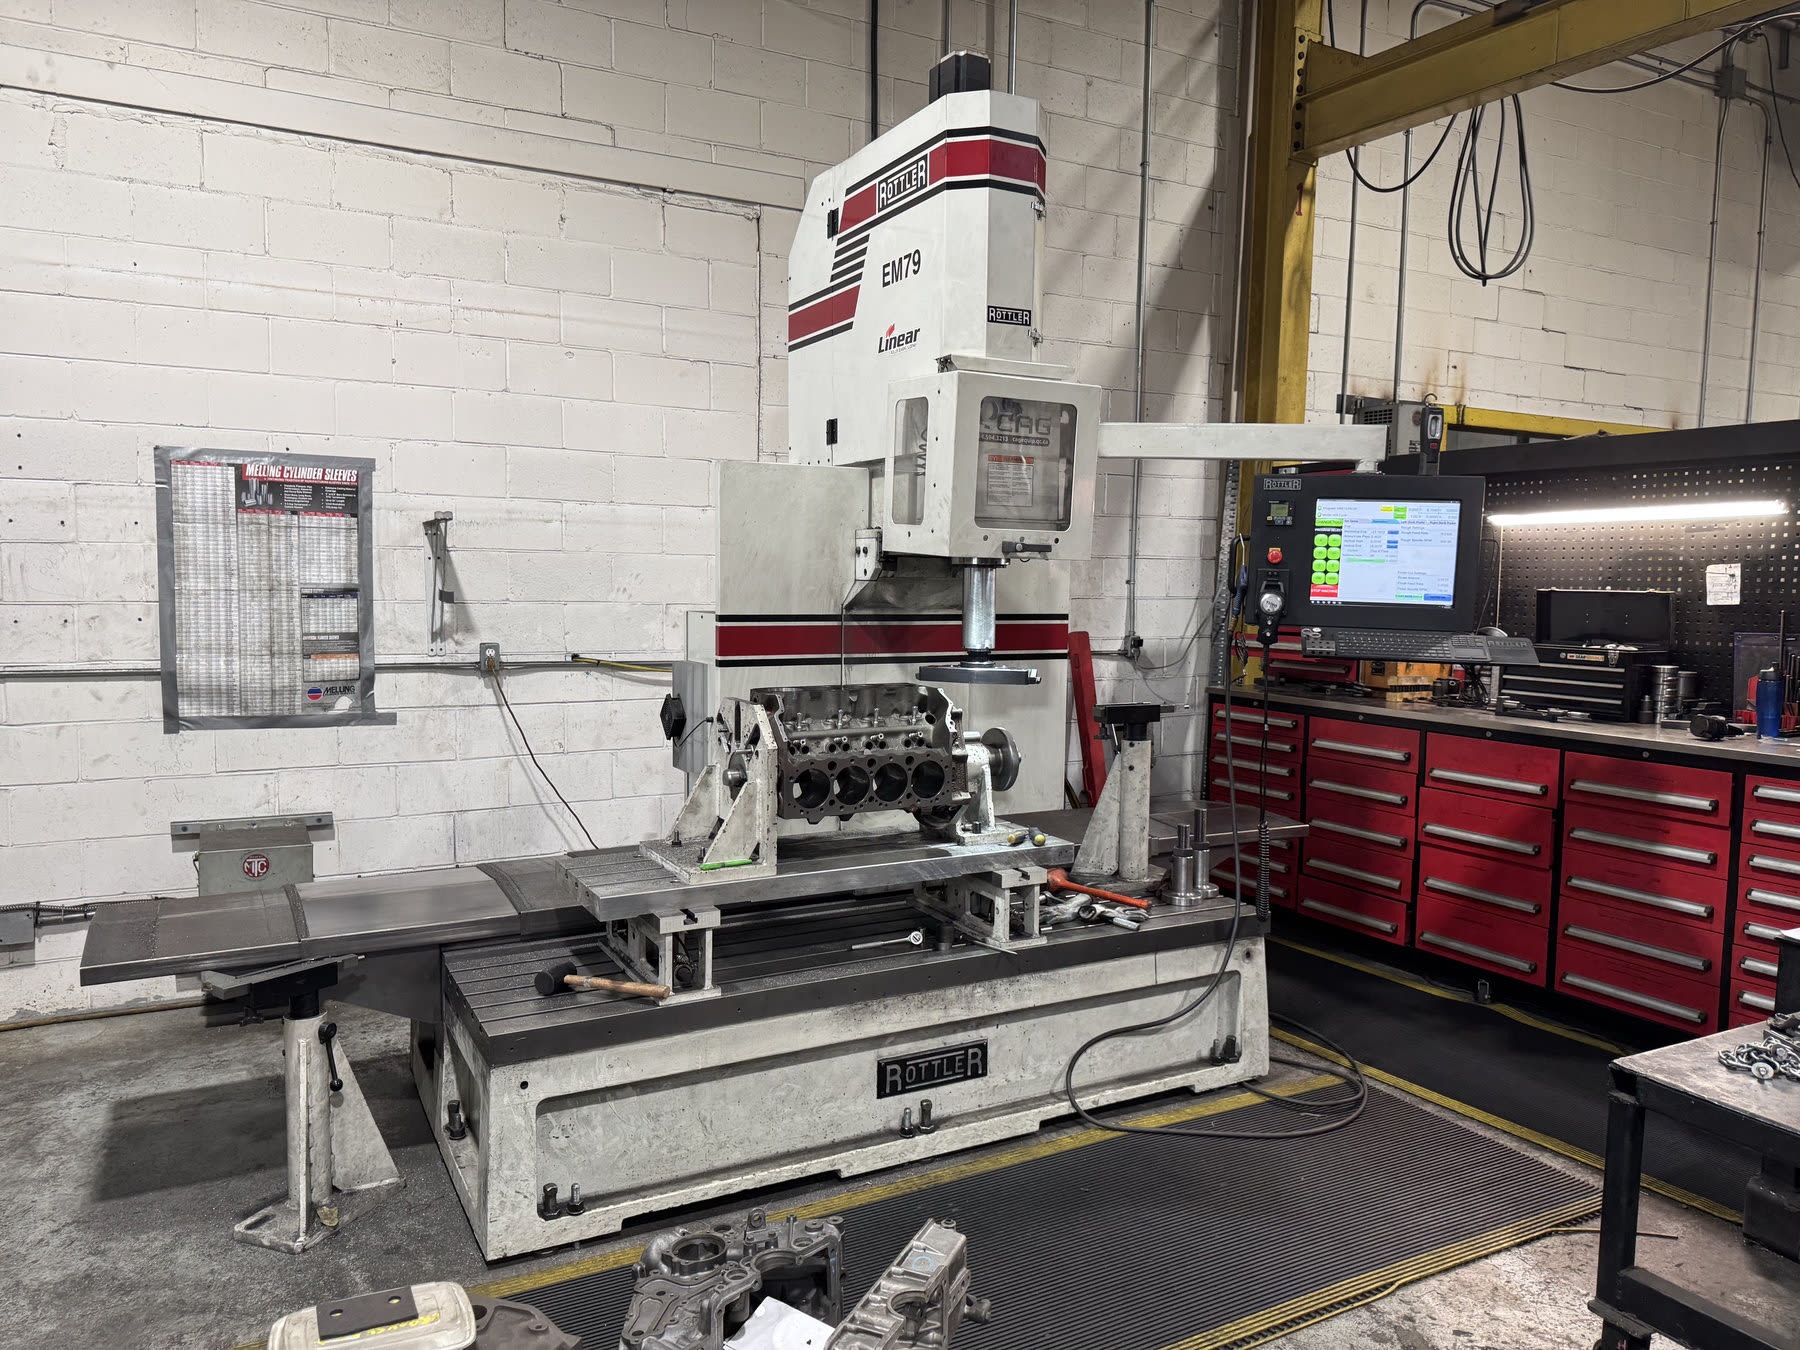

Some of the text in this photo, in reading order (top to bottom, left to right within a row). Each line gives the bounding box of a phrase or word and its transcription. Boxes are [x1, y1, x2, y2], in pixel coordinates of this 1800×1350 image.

[879, 159, 927, 209] ROTTLER
[882, 249, 921, 288] EM79
[988, 307, 1030, 325] ROTTLER
[878, 324, 921, 354] Linear
[245, 464, 358, 482] MELLING CYLINDER SLEEVES
[1264, 479, 1300, 490] ROTTLER
[322, 685, 356, 697] MELLING
[885, 1047, 984, 1094] ROTTLER
